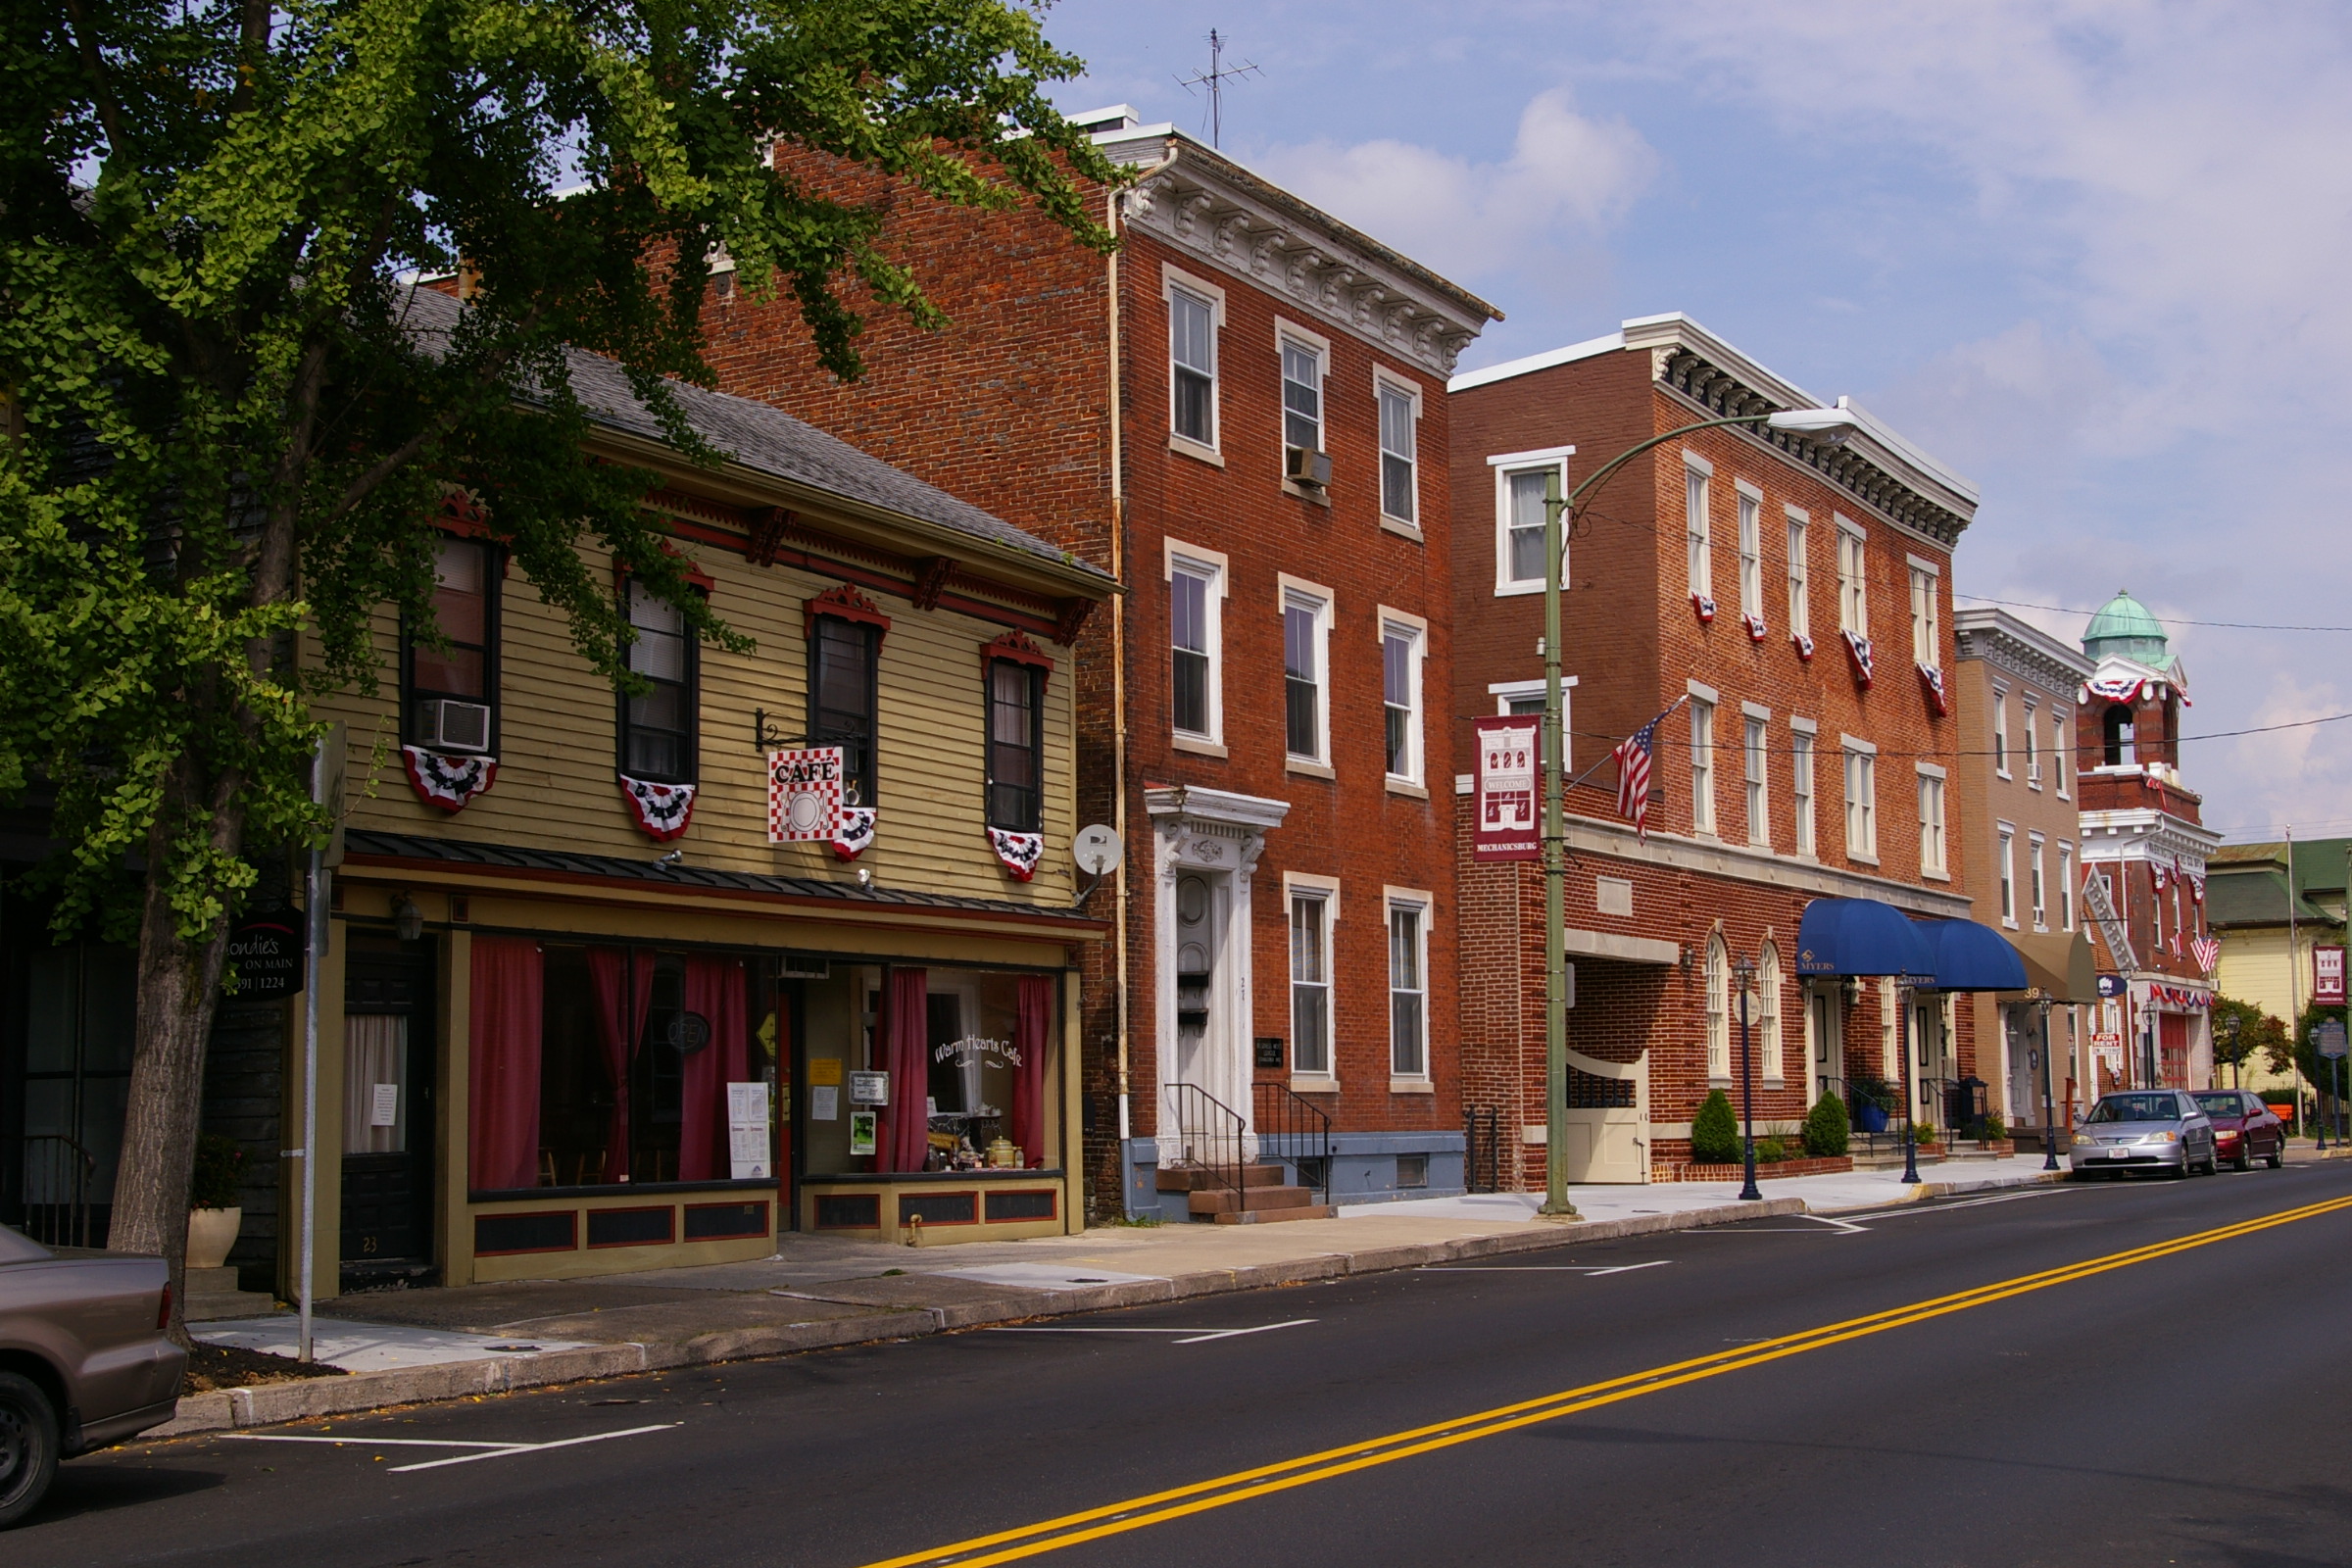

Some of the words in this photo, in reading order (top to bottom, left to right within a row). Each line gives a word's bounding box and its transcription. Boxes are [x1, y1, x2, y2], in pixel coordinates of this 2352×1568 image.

[774, 756, 836, 784] CAFÉ
[1488, 779, 1527, 790] WELCOME
[1476, 841, 1538, 853] MECHANICSBURG
[226, 933, 279, 956] ondie's
[245, 958, 263, 970] ON
[265, 957, 293, 969] MAIN
[1800, 961, 1835, 971] MYERS
[260, 976, 284, 989] 1224
[2024, 987, 2039, 999] 39
[667, 1021, 708, 1044] OPEN
[934, 1039, 964, 1064] Warm
[966, 1033, 1001, 1054] Hearts
[1001, 1040, 1023, 1067] Cafe
[363, 1236, 377, 1252] 23
